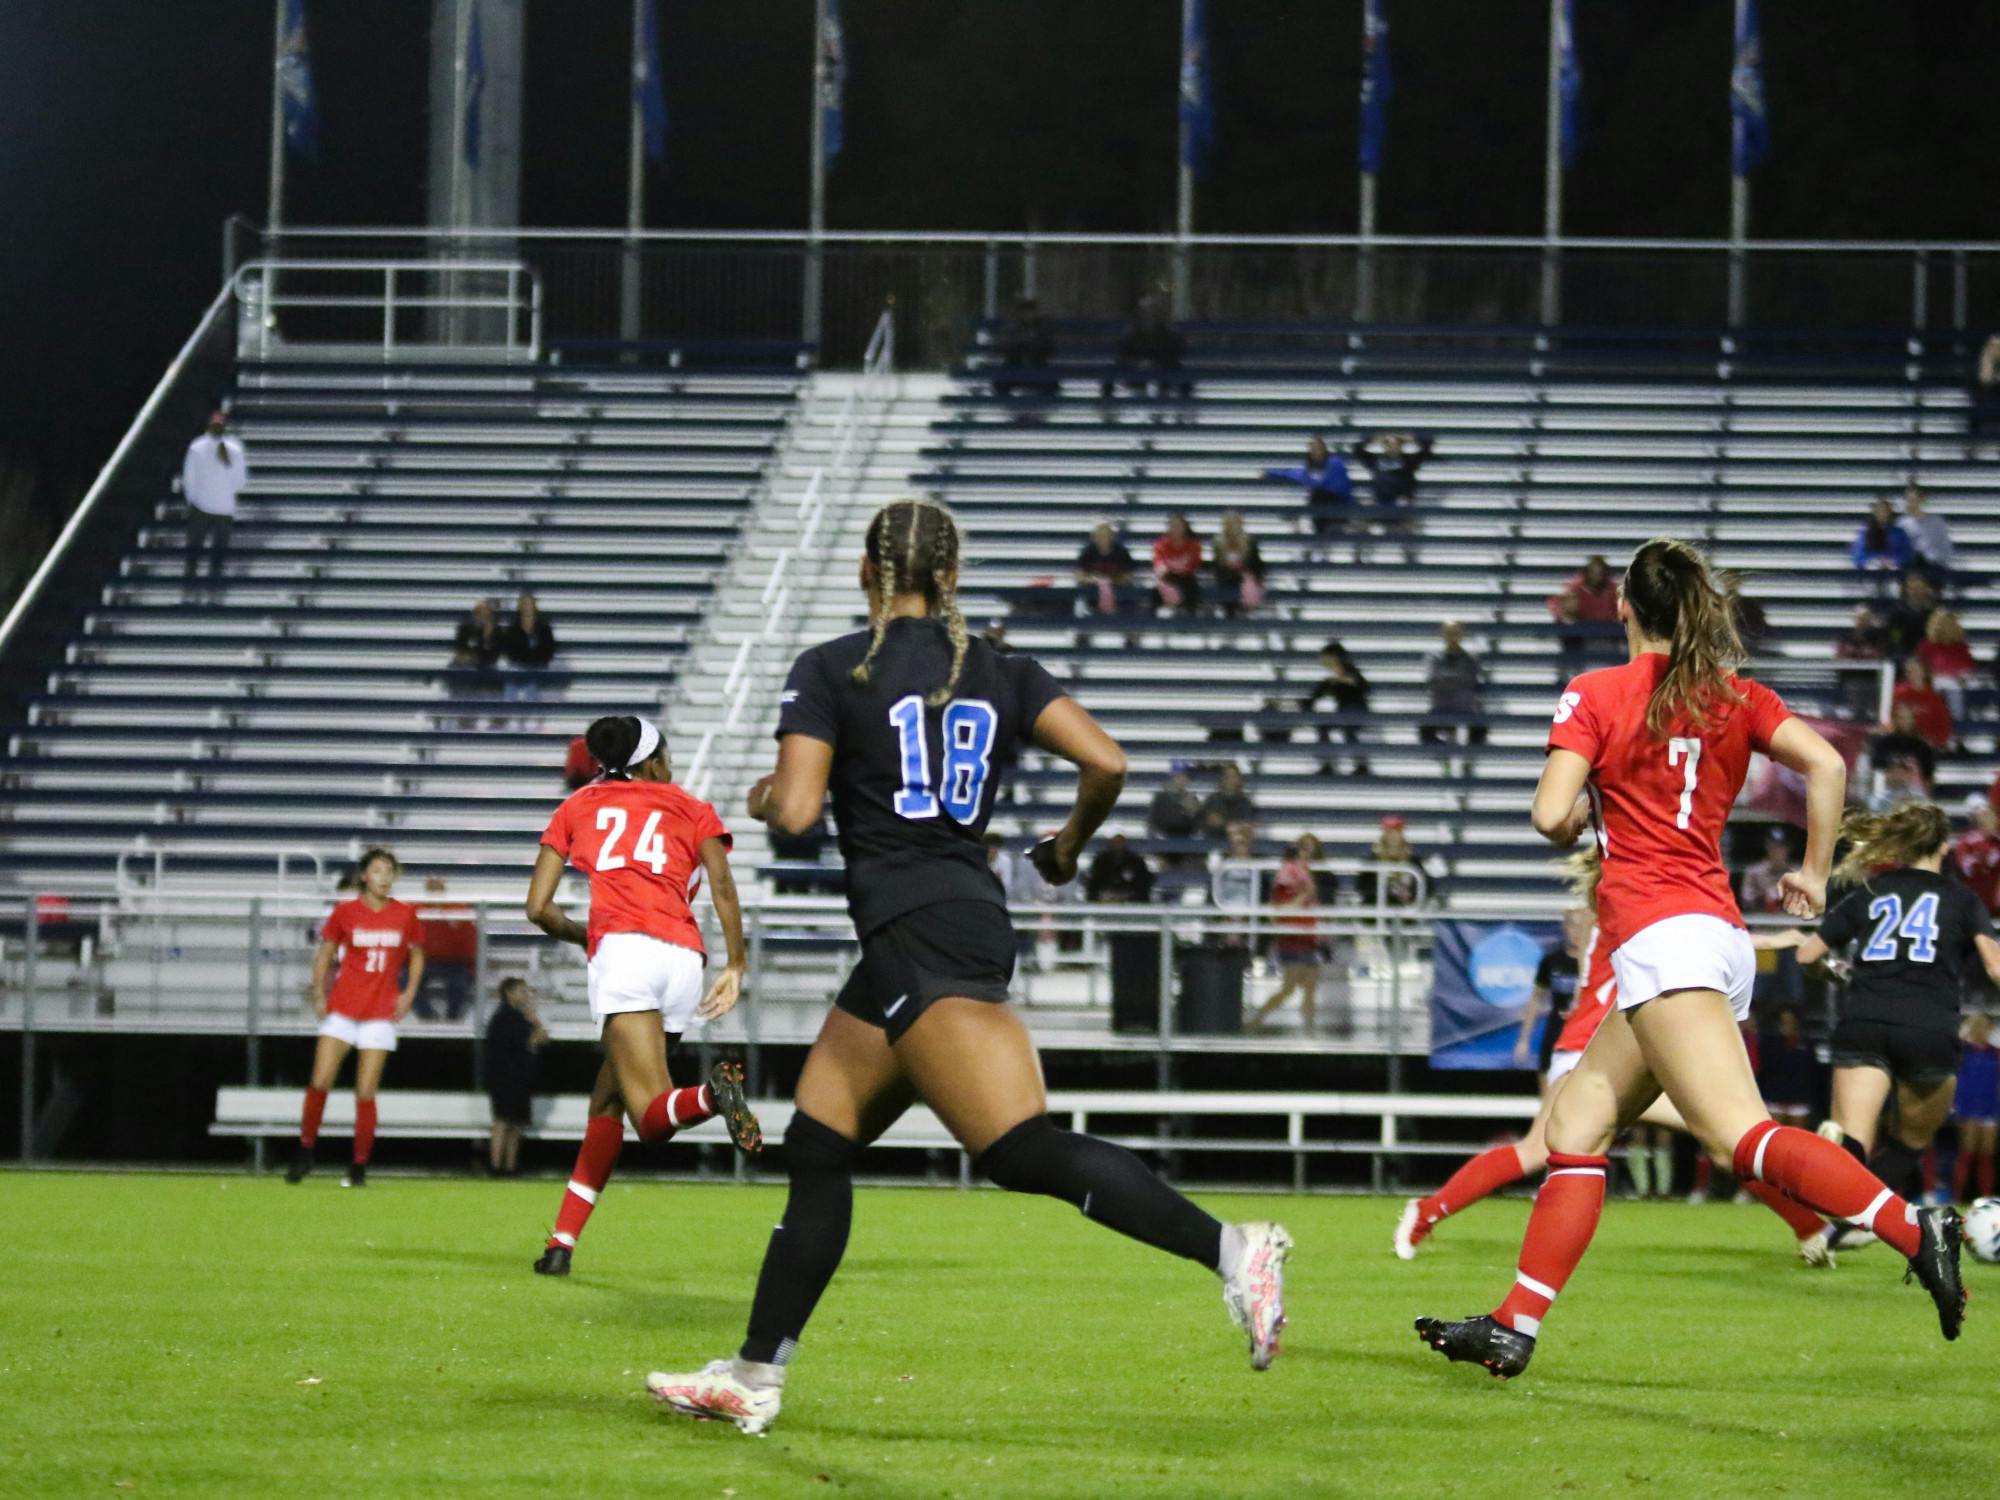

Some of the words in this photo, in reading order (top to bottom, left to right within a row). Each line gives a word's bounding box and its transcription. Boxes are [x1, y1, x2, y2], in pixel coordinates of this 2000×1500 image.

[889, 695, 998, 825] 18
[1669, 737, 1701, 829] 7
[596, 807, 668, 874] 24
[1862, 891, 1939, 963] 24
